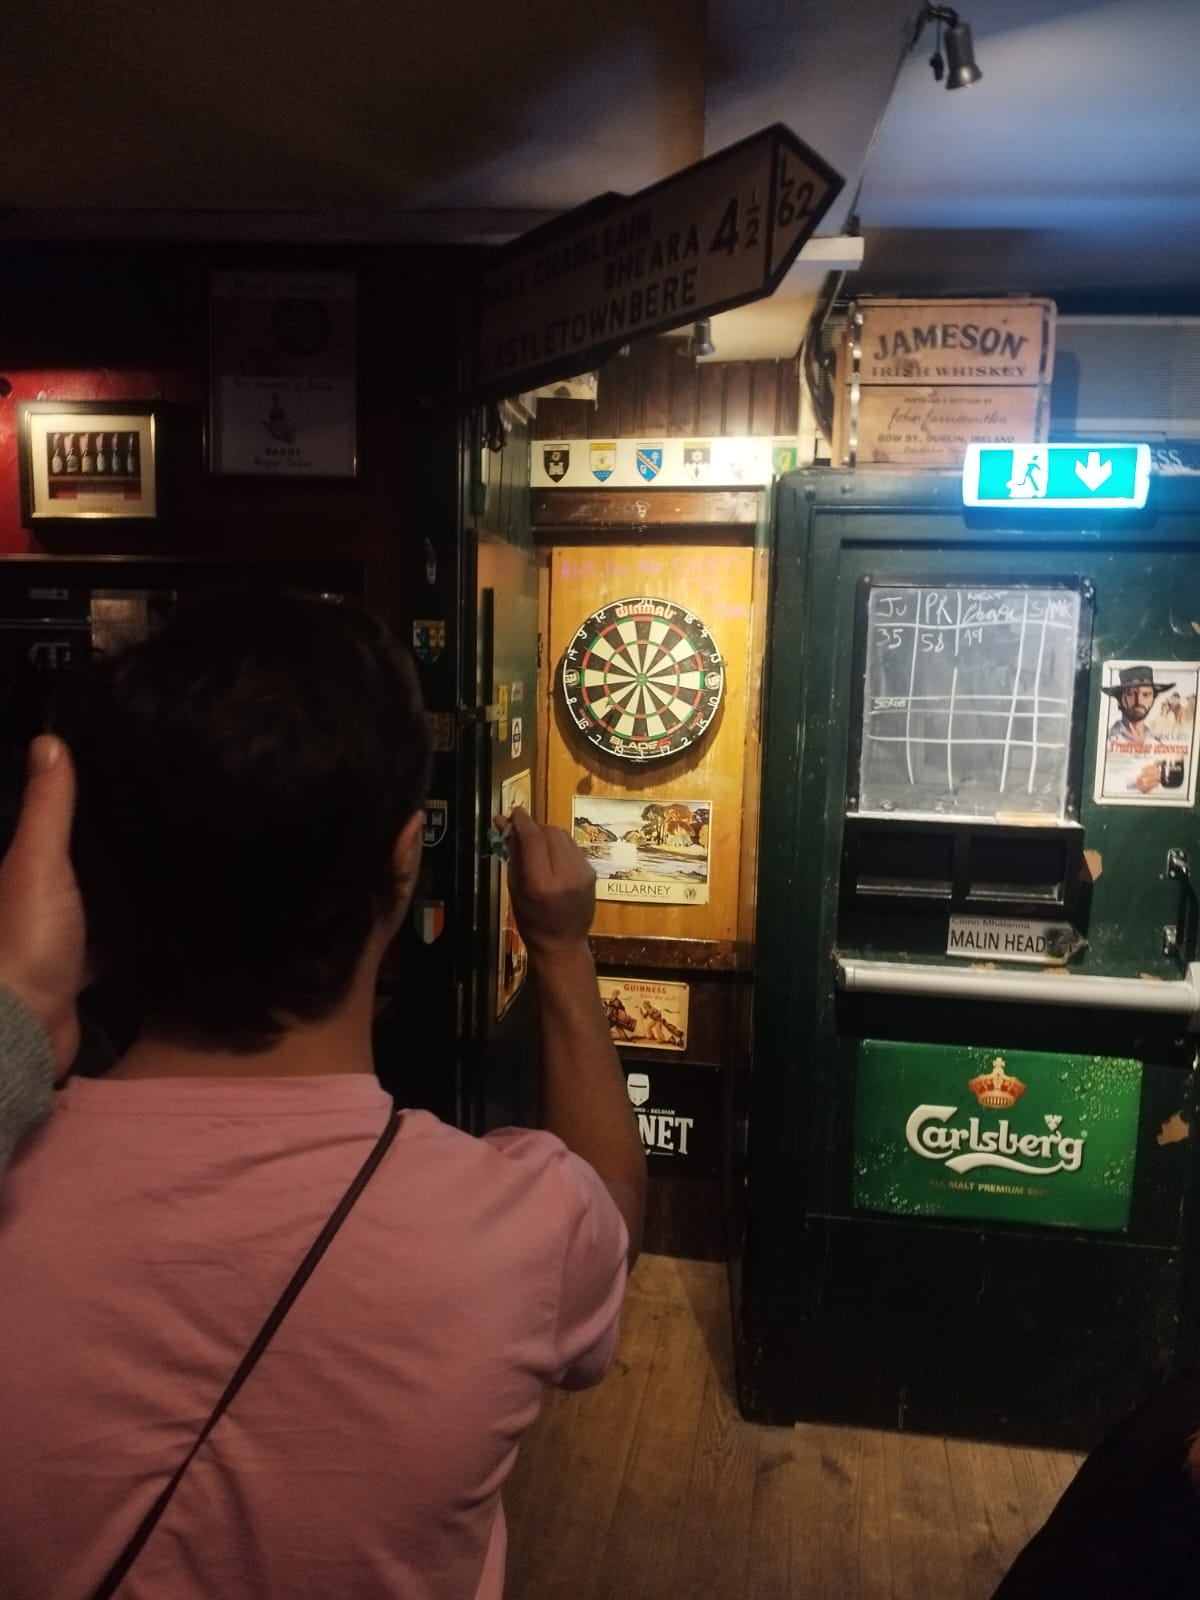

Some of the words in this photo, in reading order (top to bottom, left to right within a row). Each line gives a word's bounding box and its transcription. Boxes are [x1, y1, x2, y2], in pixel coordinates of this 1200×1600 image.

[779, 153, 794, 189] L
[778, 182, 814, 227] 62
[481, 266, 698, 377] CASTLETOWNBERE
[873, 323, 1030, 361] JAMESON
[871, 365, 931, 379] IRISH
[935, 365, 1027, 379] WHISKEY
[878, 434, 902, 443] BOW
[925, 591, 953, 624] PK
[875, 628, 904, 650] 35
[920, 632, 945, 653] 58
[607, 883, 672, 896] KILLARNEY
[950, 929, 1000, 950] MALIN
[1004, 934, 1048, 953] HEAD
[623, 983, 667, 994] GUINNESS
[637, 1114, 694, 1155] NET
[905, 1104, 1085, 1175] Carlsberg
[948, 1181, 975, 1192] MALT
[977, 1183, 1024, 1196] PREMIUM
